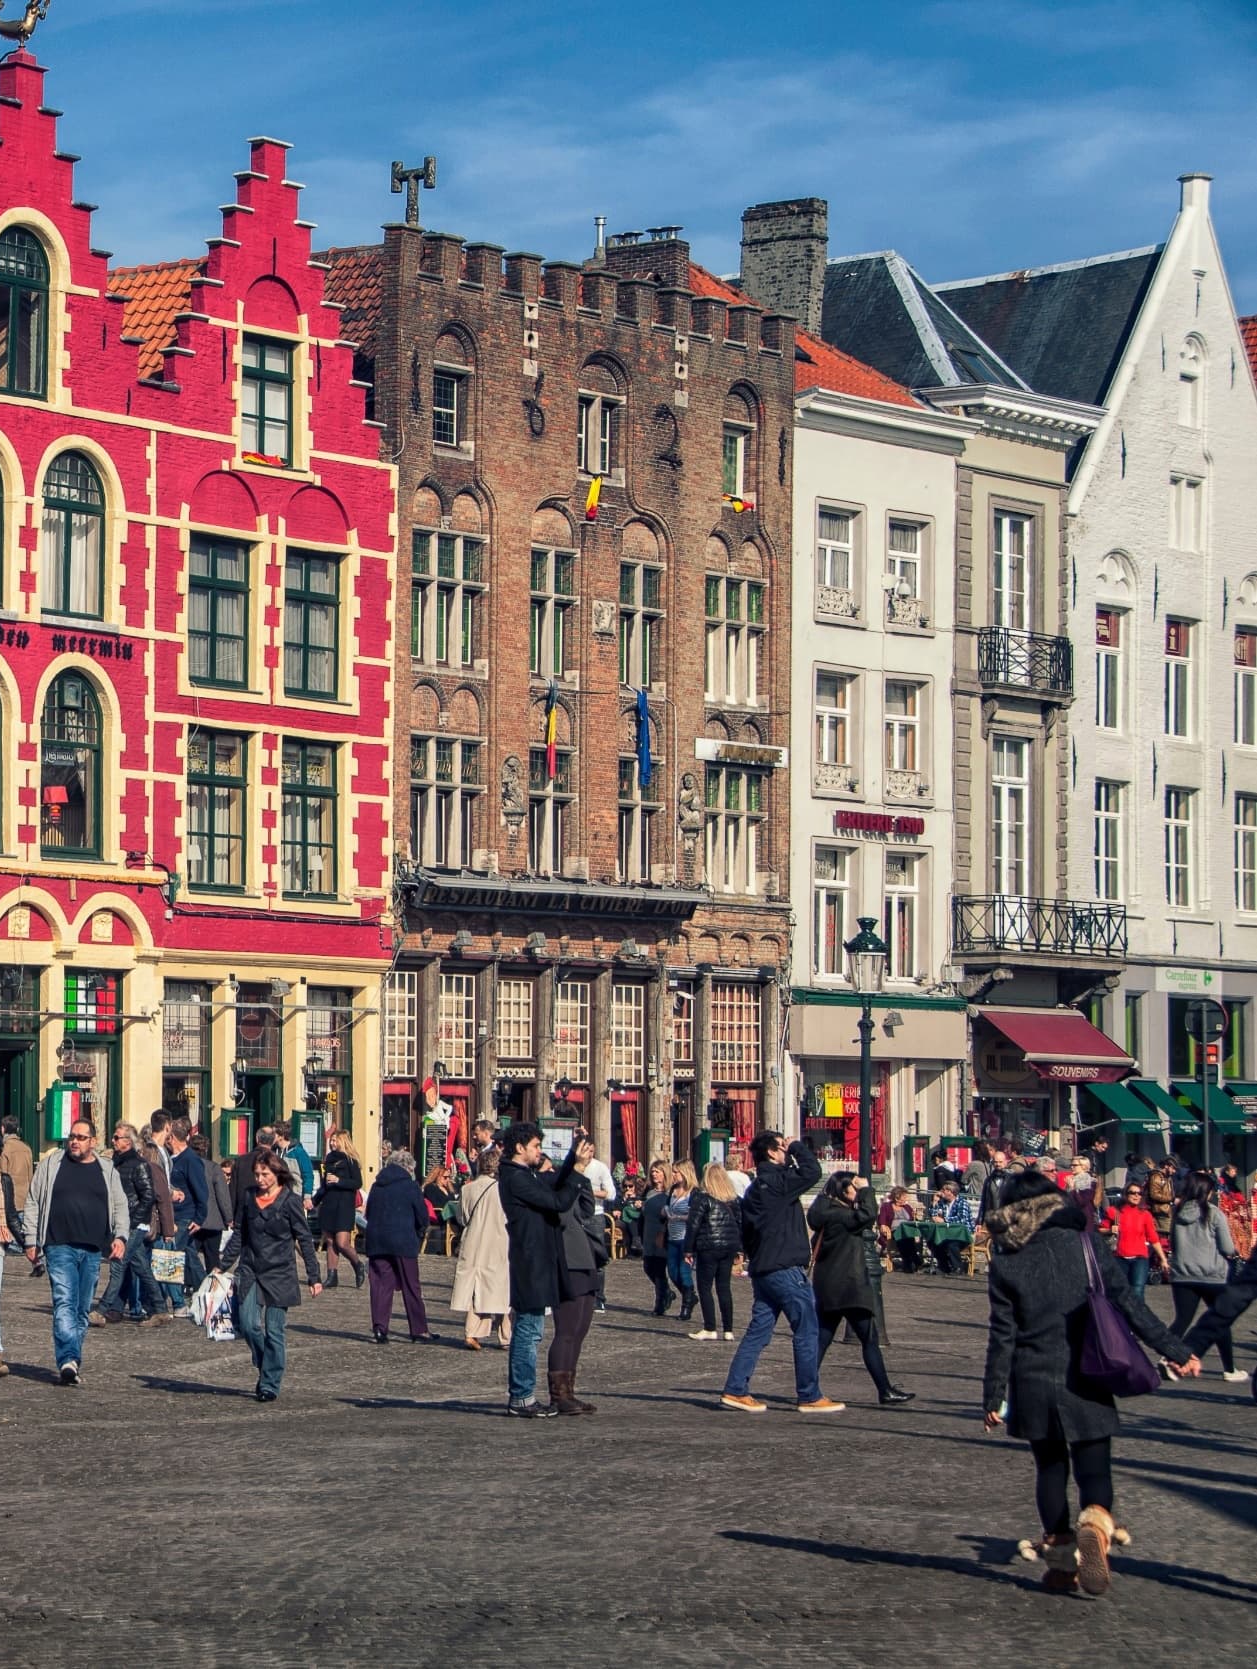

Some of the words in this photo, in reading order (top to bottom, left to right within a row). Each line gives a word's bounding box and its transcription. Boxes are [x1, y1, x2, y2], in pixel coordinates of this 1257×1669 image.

[424, 885, 539, 908] RESTAURANT
[547, 892, 570, 911] LA
[1049, 1065, 1099, 1078] SOUVENIRS
